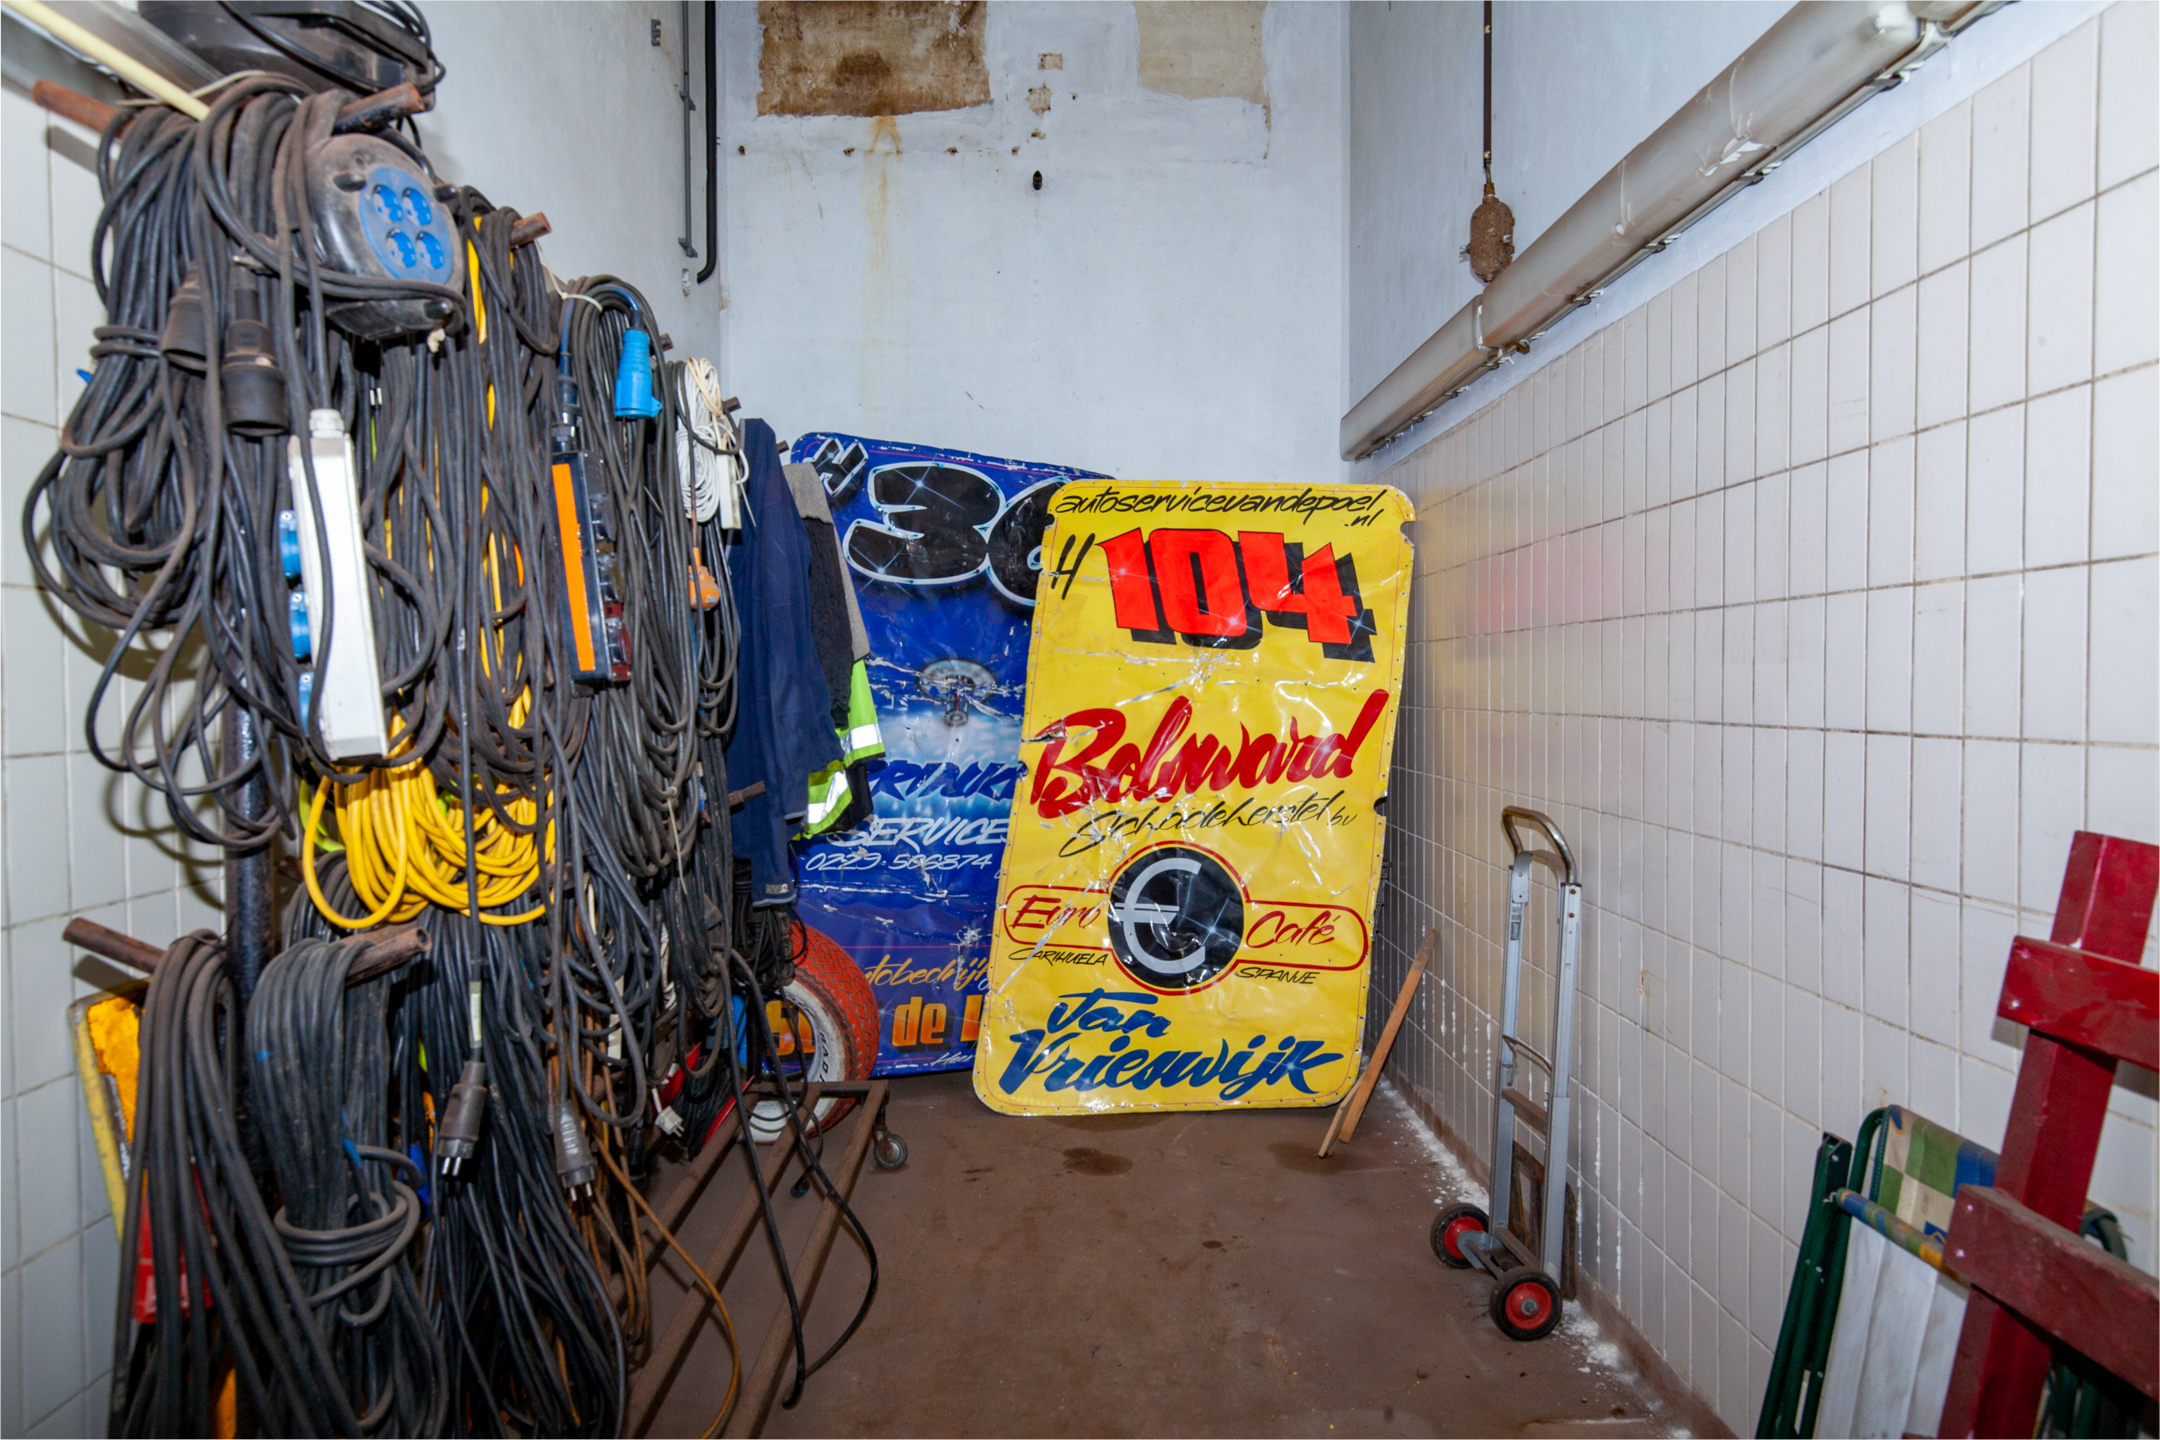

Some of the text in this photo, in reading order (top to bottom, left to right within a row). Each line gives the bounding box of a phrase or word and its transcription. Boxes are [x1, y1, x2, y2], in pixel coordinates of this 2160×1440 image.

[1051, 526, 1377, 659] H 104
[825, 815, 1009, 854] SERVICE
[1009, 894, 1102, 930] Euro
[1245, 910, 1342, 949] Café
[1008, 946, 1320, 986] CARIHUELA SPANJE
[891, 996, 949, 1048] de
[1046, 987, 1172, 1039] Jan
[998, 1028, 1345, 1101] Vrieswijk
